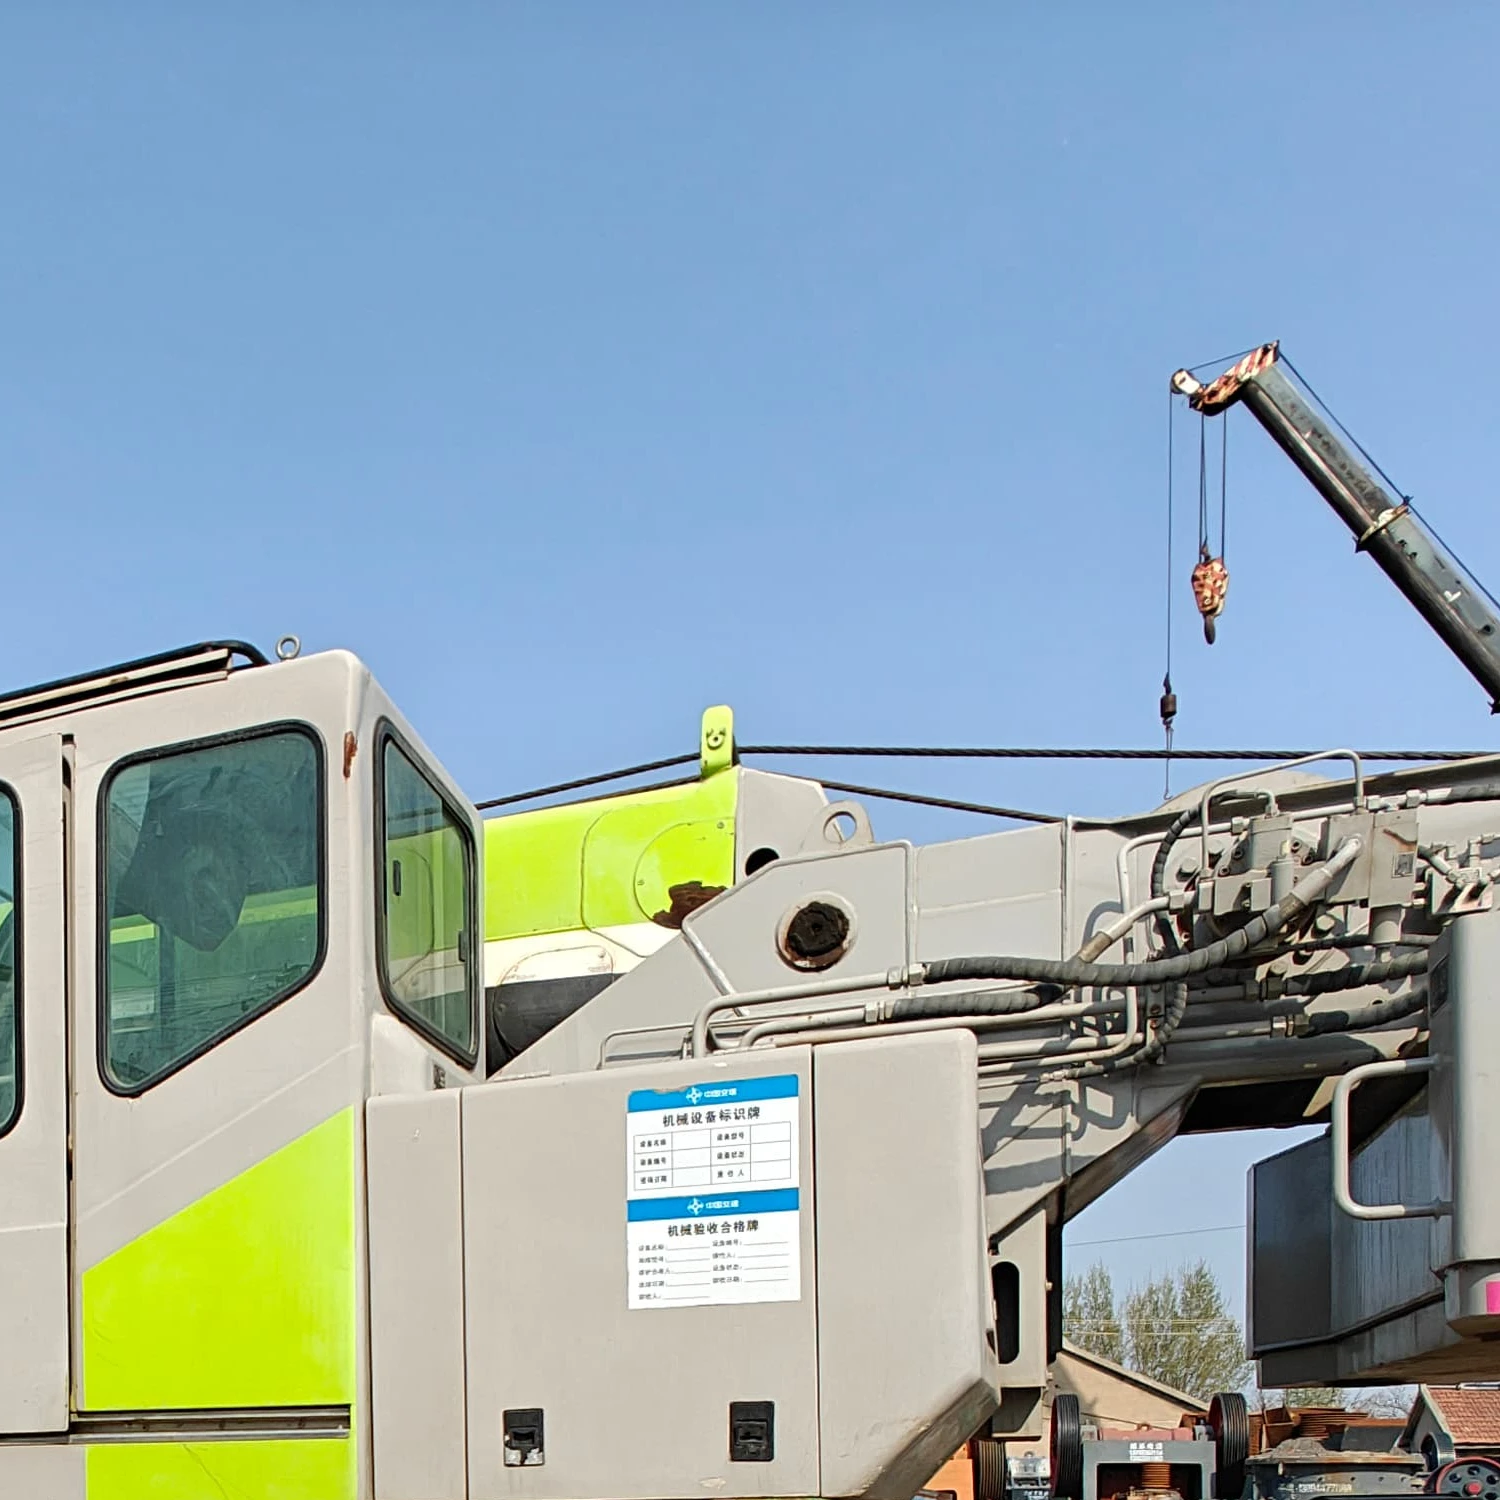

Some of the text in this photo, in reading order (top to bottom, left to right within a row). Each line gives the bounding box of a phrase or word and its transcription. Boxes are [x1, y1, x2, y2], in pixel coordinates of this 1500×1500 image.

[662, 1106, 760, 1127] 机械设备标识牌
[667, 1219, 760, 1237] 机械验收合格牌
